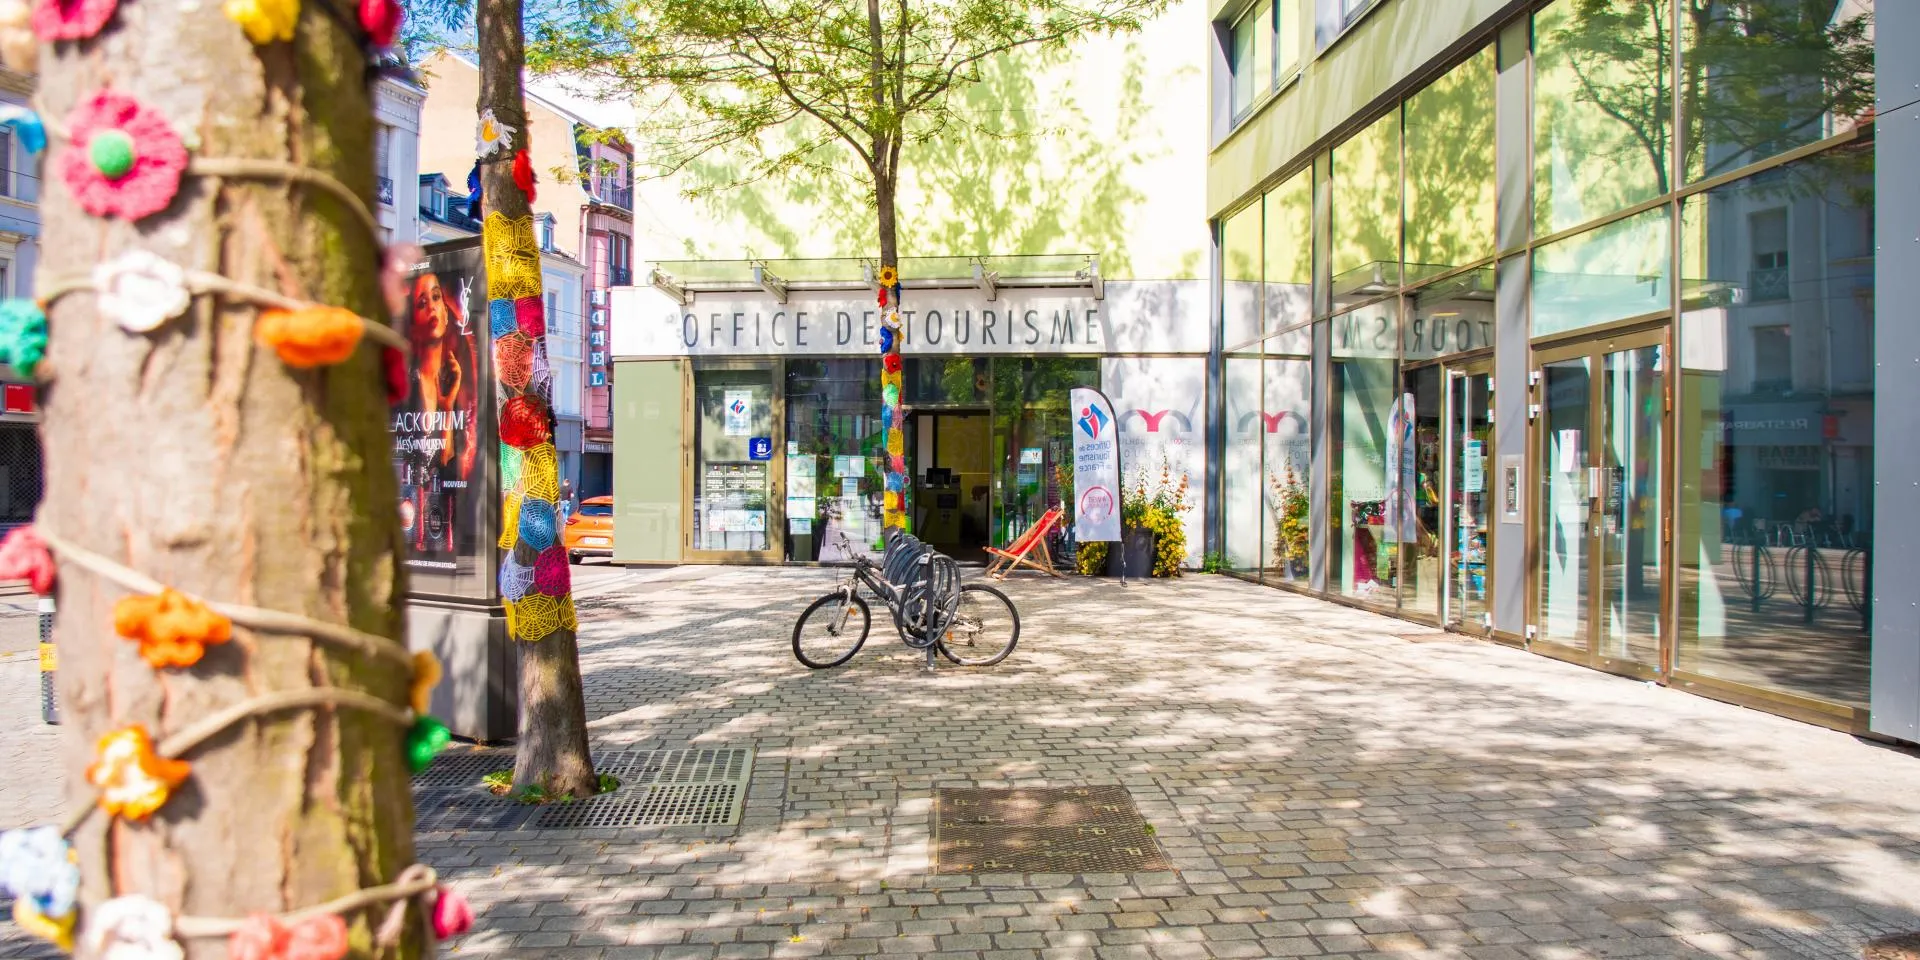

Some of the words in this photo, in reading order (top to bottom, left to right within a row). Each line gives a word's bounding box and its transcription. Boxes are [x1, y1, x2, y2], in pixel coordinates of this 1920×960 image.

[683, 311, 808, 347] OFFICE
[836, 311, 875, 346] DE
[902, 310, 1098, 345] TOURISME
[391, 411, 421, 432] ACK
[422, 410, 464, 432] OPIUM
[443, 480, 468, 488] NOUVEAU
